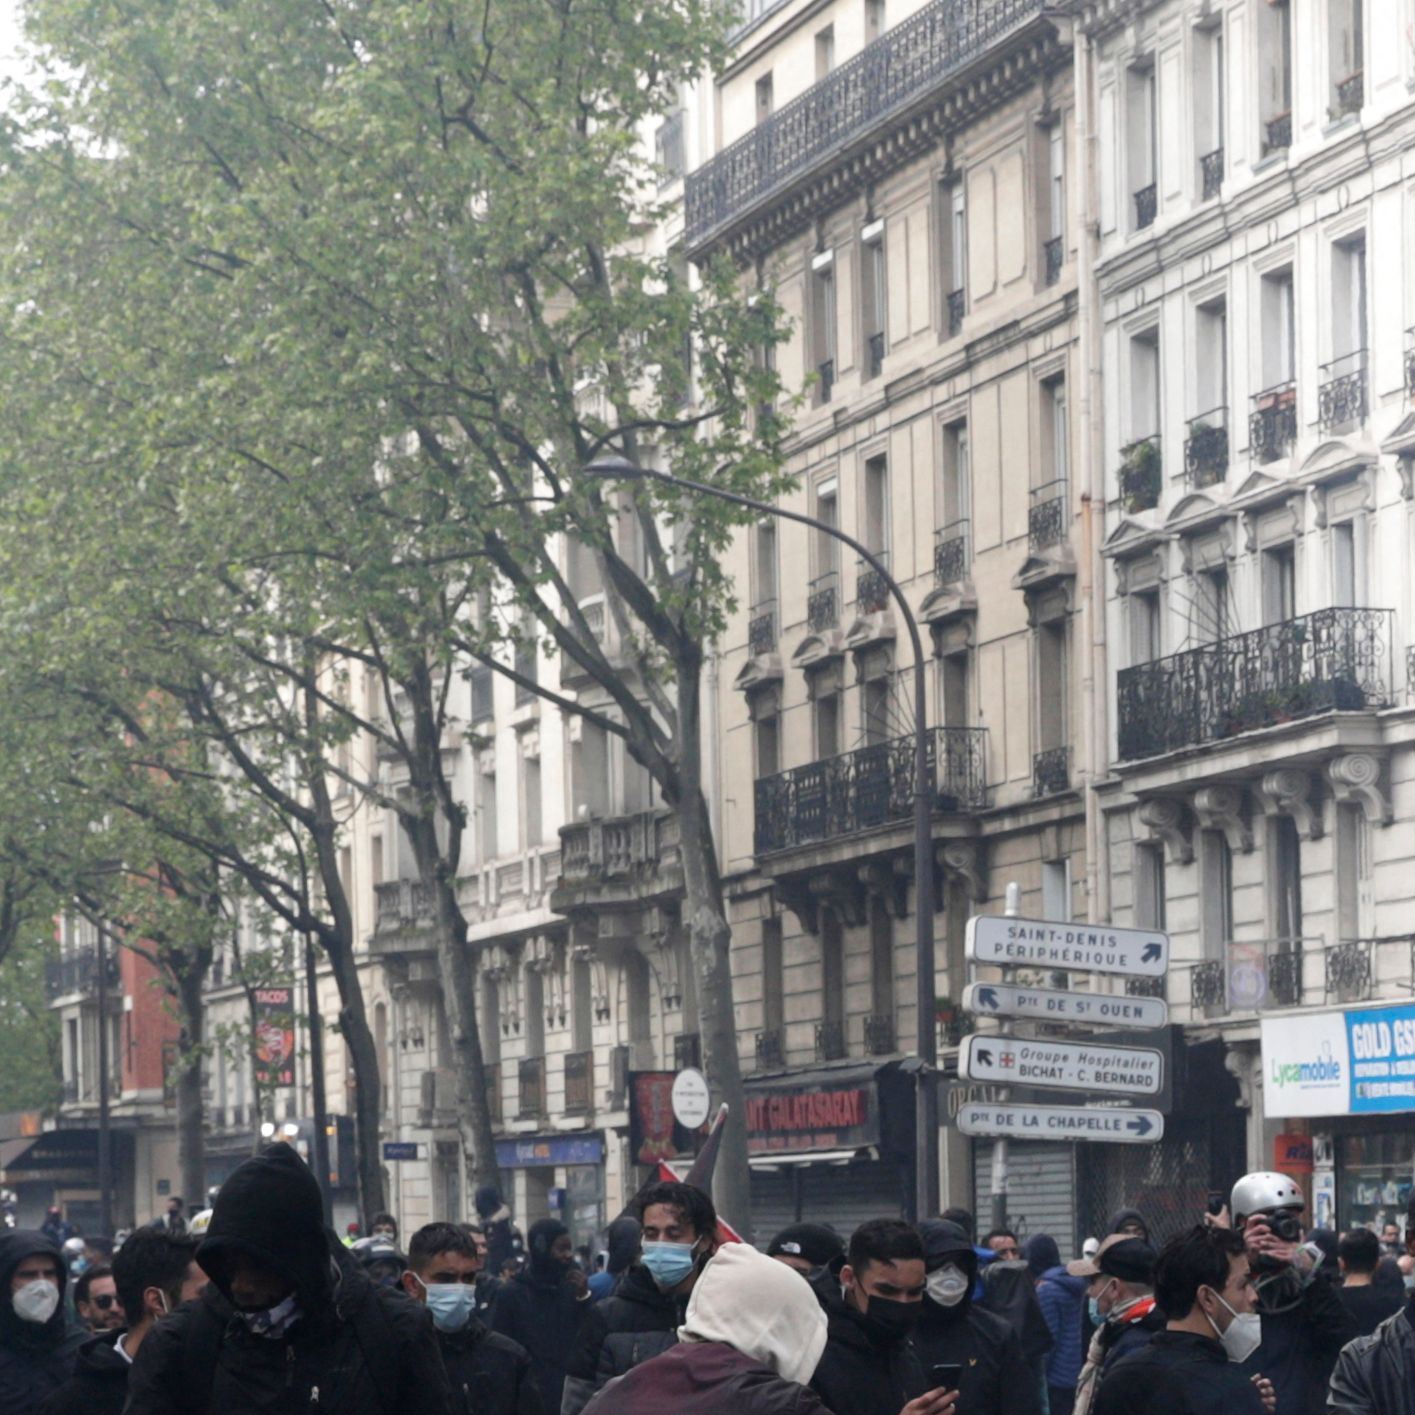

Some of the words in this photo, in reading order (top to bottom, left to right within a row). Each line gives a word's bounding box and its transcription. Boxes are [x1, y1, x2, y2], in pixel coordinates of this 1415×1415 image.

[1007, 926, 1118, 948] SAINT-DENIS
[994, 940, 1128, 967] PÉRIPHÉRIQUE
[255, 990, 288, 1003] TACOS
[1047, 999, 1066, 1012] DE
[1100, 1005, 1143, 1018] OUEN
[1352, 1021, 1392, 1060] GOLD
[1020, 1047, 1069, 1067] Groupe
[1078, 1051, 1154, 1071] Hospitalier
[1271, 1054, 1341, 1088] Lycamobile
[1019, 1063, 1064, 1080] BICHAT
[1077, 1068, 1090, 1082] C.
[1095, 1071, 1154, 1088] BERNARD
[768, 1089, 861, 1131] GALATASARAY
[996, 1113, 1014, 1126] DE
[1022, 1114, 1039, 1127] LA
[1048, 1115, 1122, 1131] CHAPELLE
